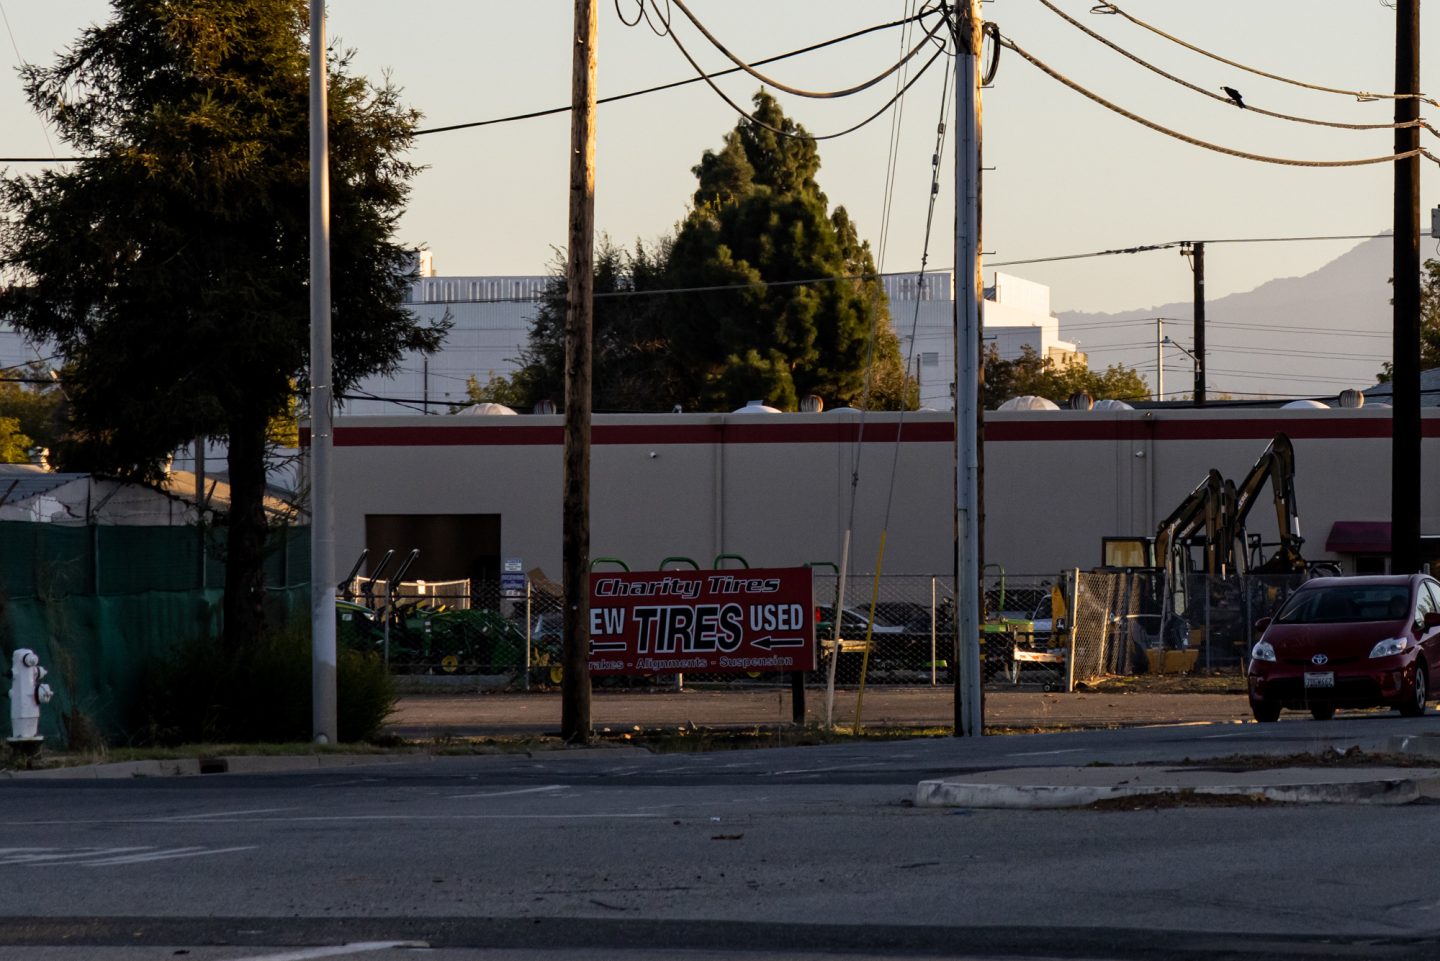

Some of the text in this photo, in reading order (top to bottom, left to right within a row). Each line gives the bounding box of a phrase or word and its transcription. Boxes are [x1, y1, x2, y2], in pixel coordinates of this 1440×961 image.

[595, 576, 780, 599] Charity Tires
[589, 603, 804, 654] EW TIRES USED
[589, 658, 624, 670] rakes
[635, 657, 707, 670] Alignments
[719, 655, 793, 668] Suspension
